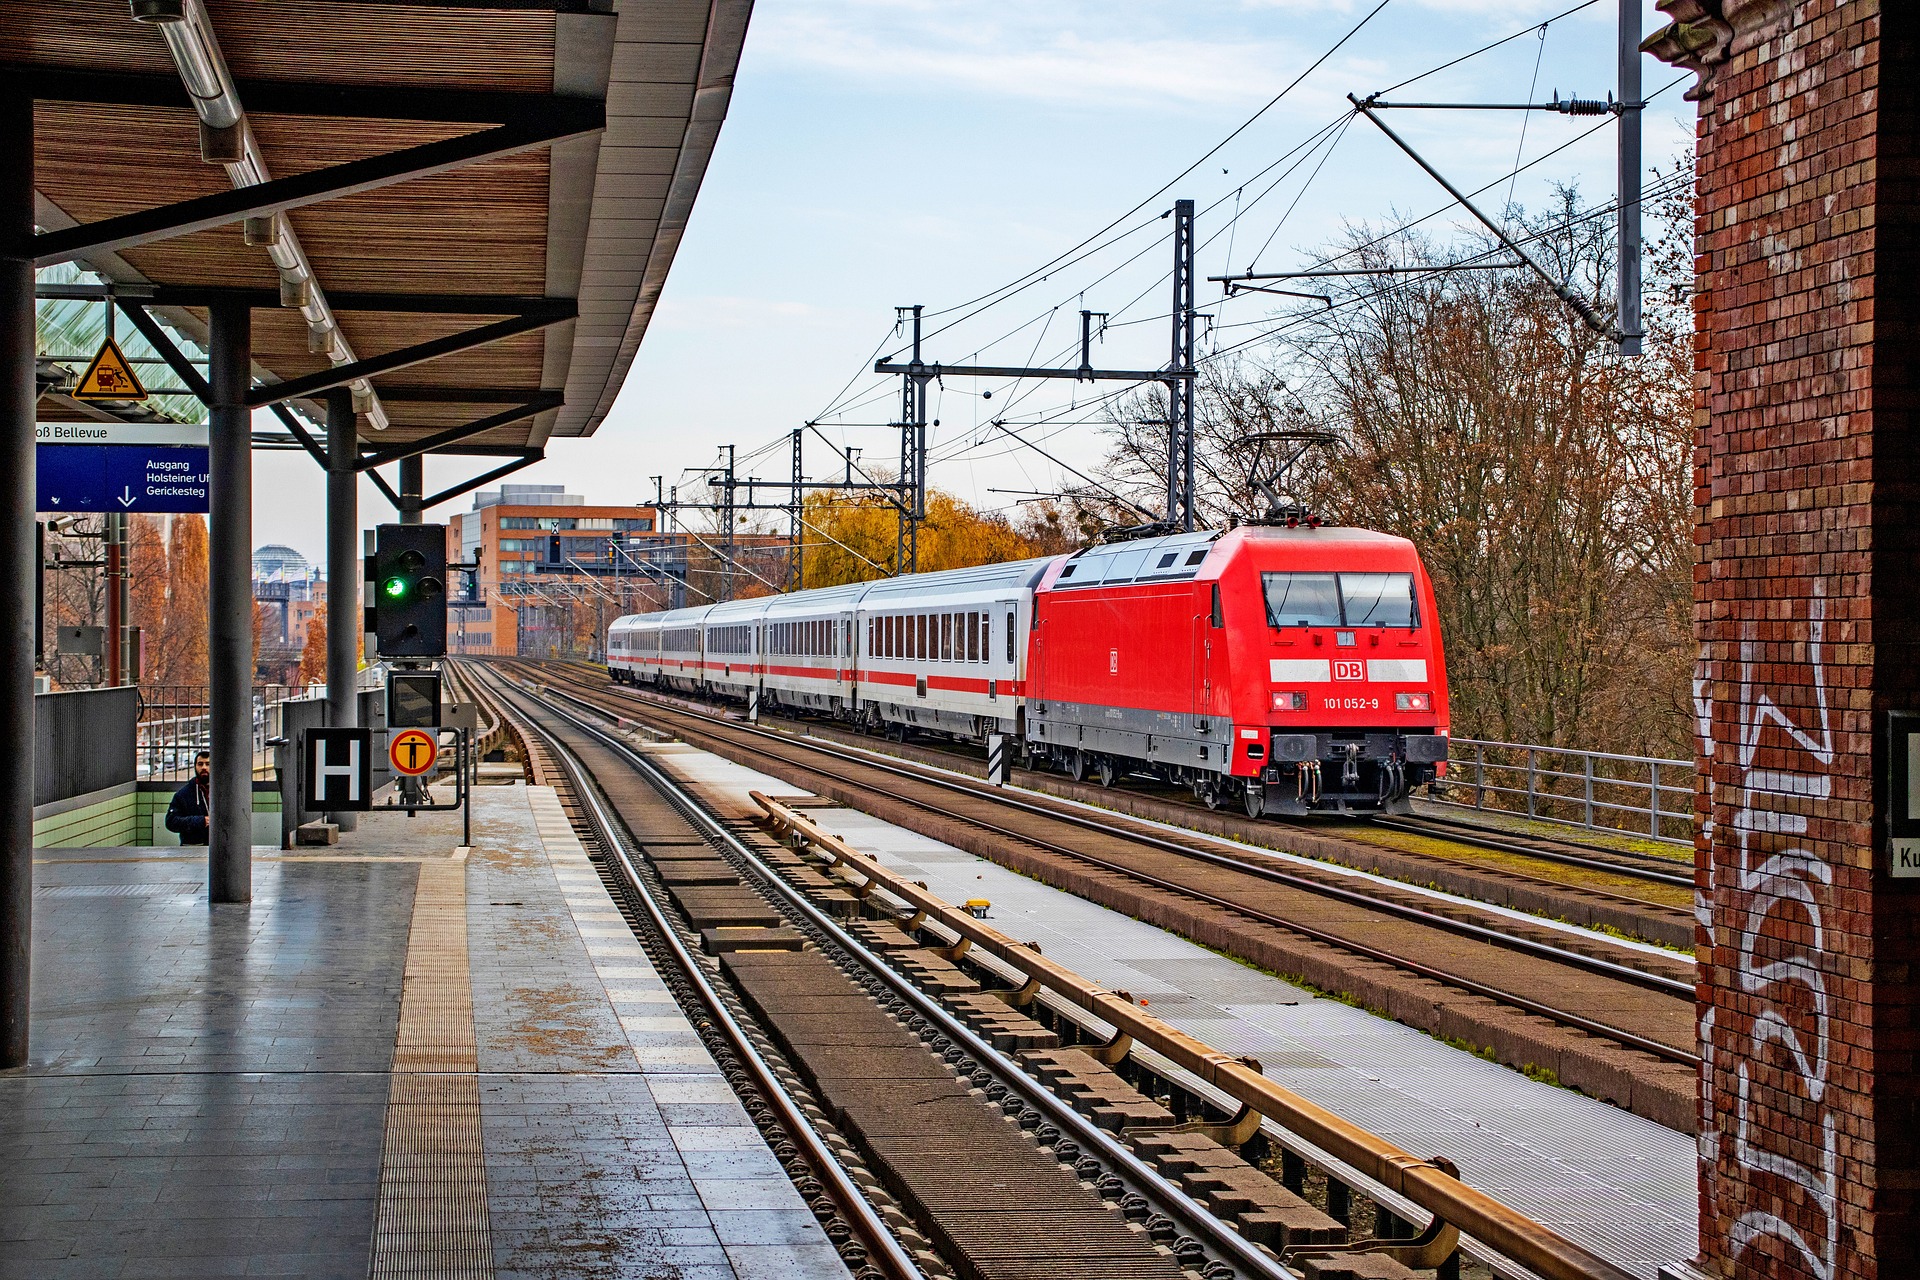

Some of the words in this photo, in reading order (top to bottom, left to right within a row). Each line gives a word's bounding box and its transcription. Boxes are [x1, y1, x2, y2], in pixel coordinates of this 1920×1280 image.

[54, 426, 108, 438] Bellevue
[146, 459, 190, 472] Ausgang
[146, 472, 196, 483] Holsteiner
[146, 485, 205, 498] Gerickesteg
[1335, 662, 1362, 679] DB
[1323, 698, 1341, 709] 101
[1343, 698, 1379, 709] 052-9
[314, 739, 361, 801] H
